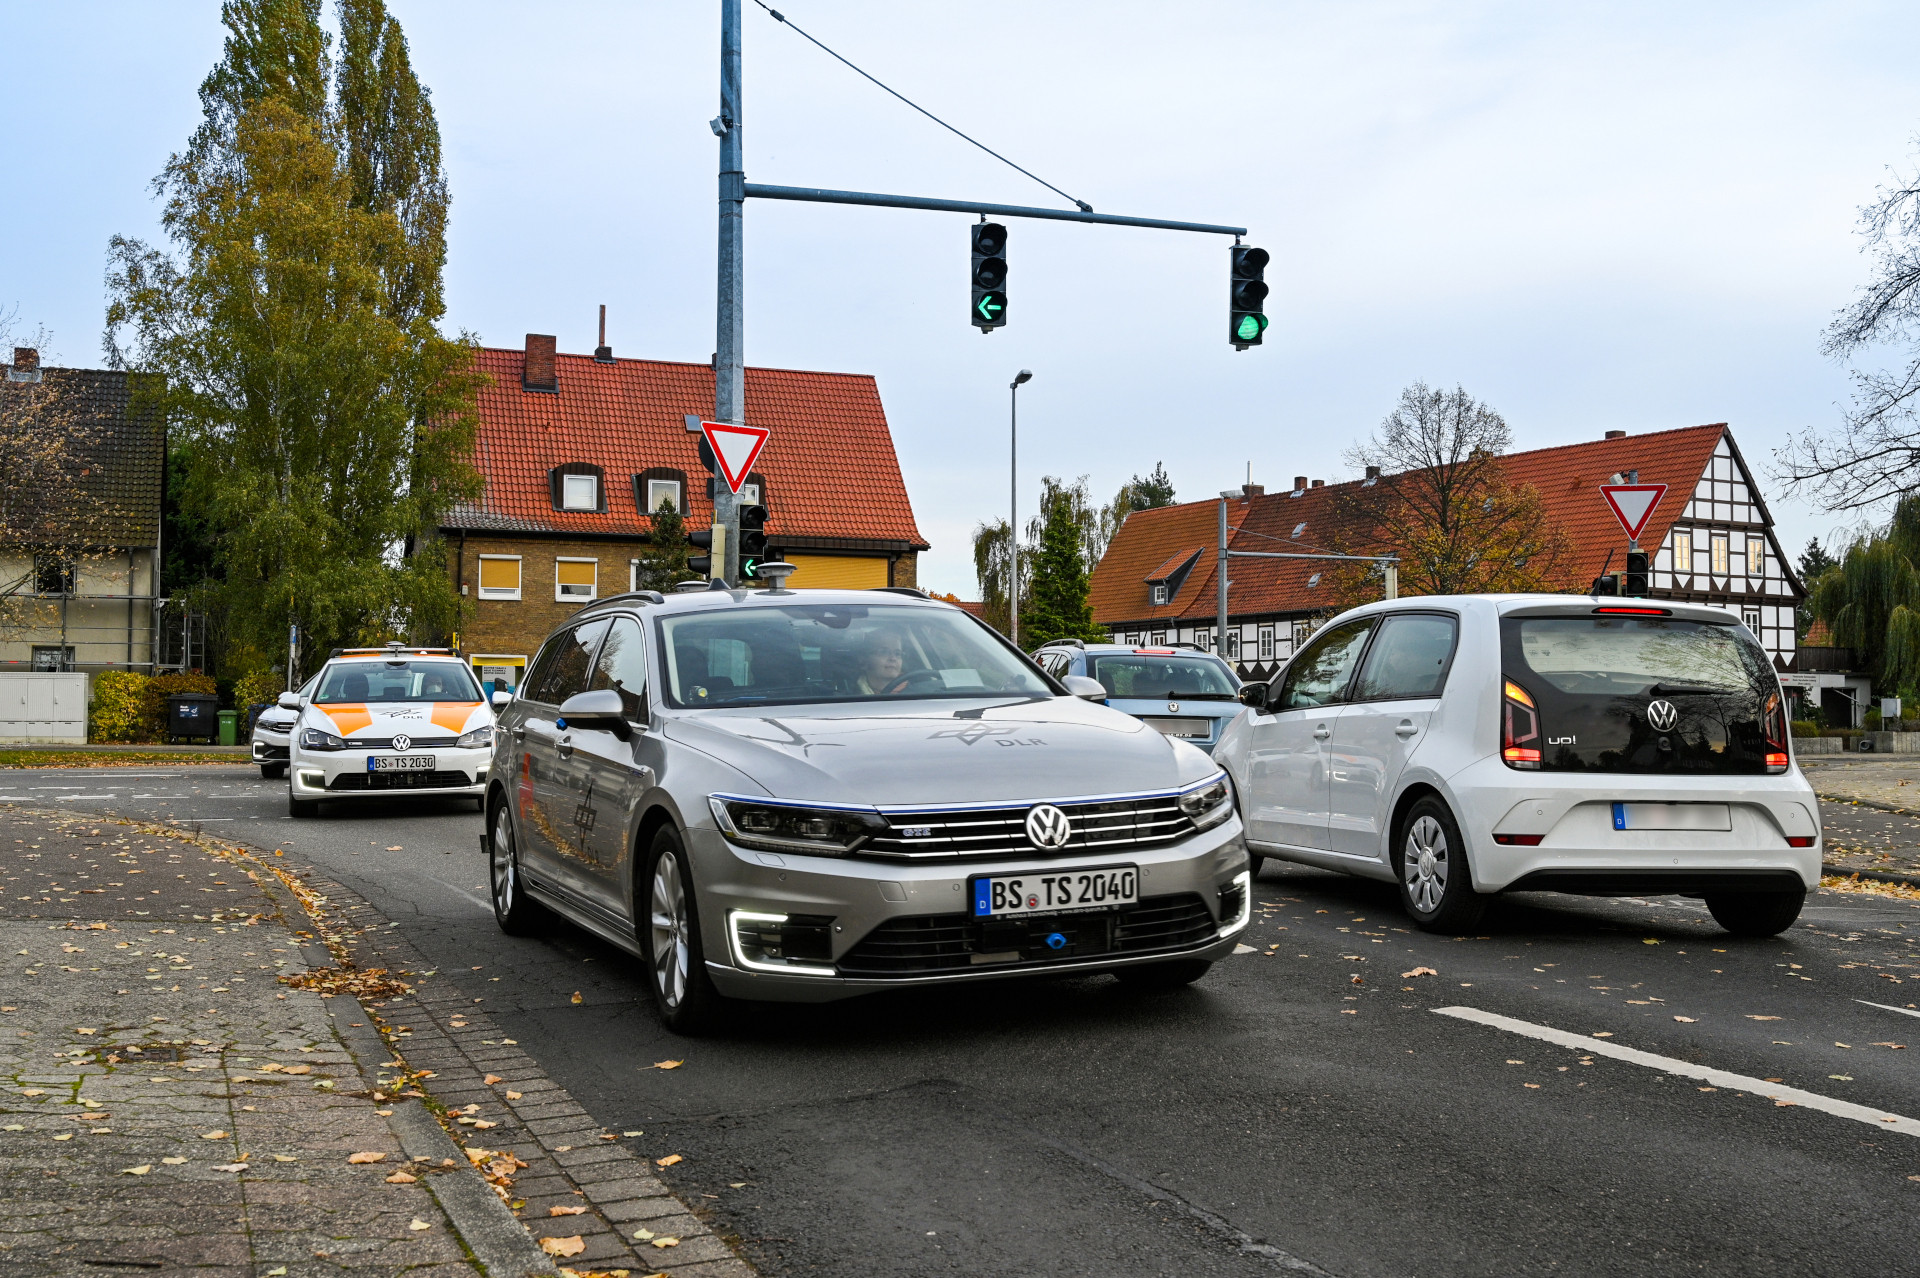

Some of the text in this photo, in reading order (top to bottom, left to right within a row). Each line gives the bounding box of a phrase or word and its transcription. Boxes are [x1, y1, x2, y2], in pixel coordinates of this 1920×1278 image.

[994, 738, 1049, 747] DLR
[375, 758, 387, 768] BS
[395, 757, 407, 768] TS
[409, 757, 433, 768] 2030
[991, 871, 1134, 910] BS TS 2040
[979, 901, 987, 909] D
